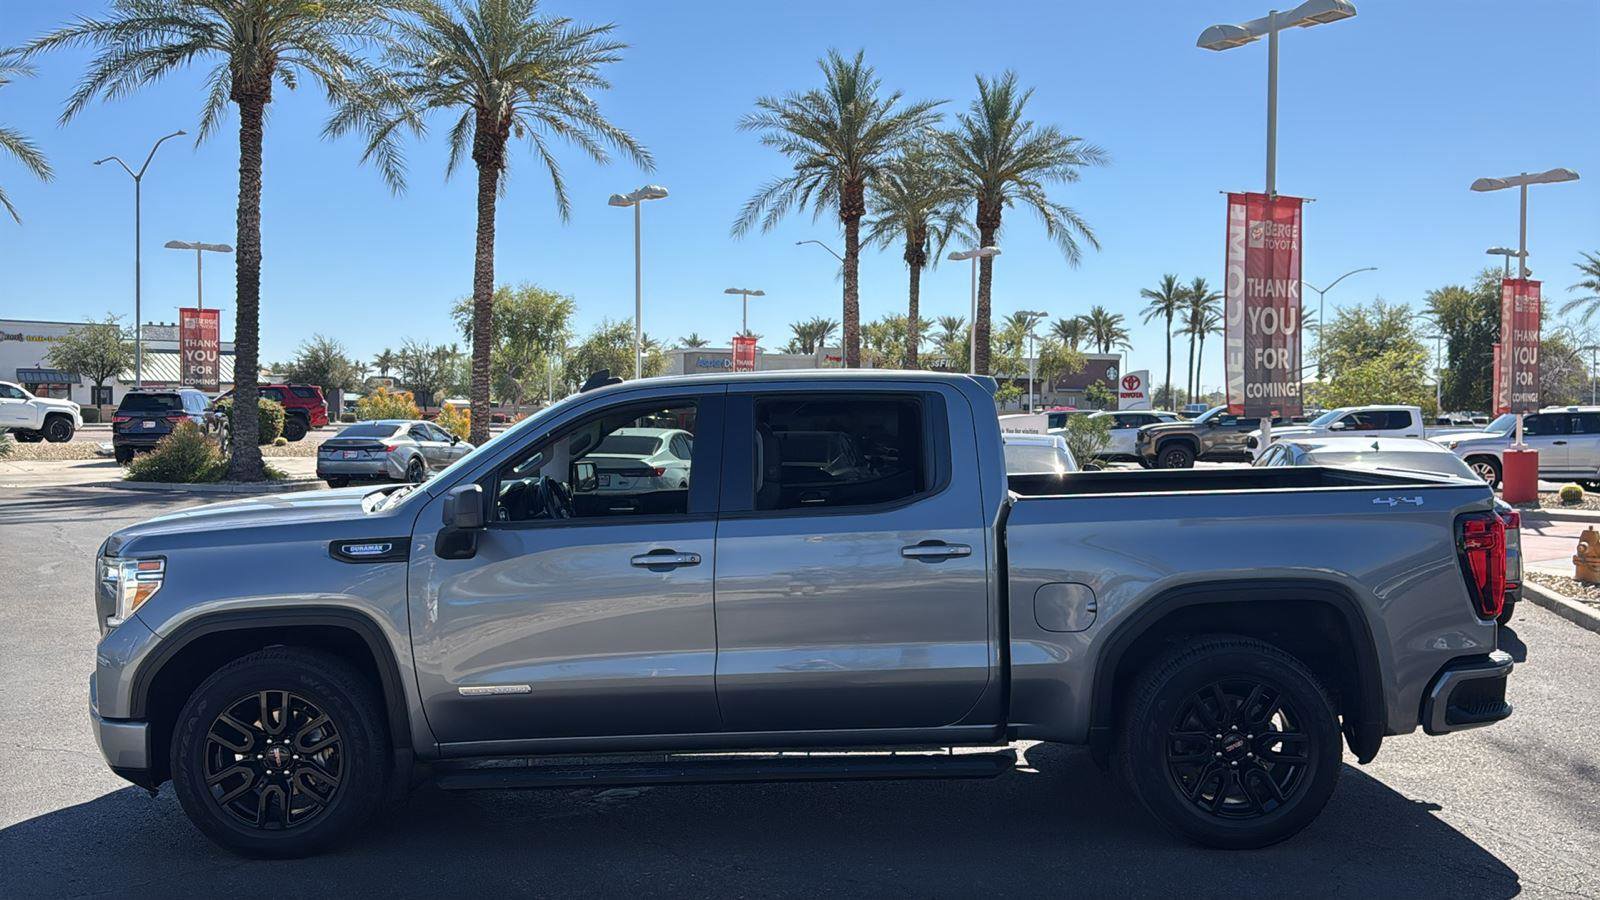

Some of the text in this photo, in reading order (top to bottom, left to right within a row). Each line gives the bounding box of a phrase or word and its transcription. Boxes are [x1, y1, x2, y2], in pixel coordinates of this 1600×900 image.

[1265, 220, 1298, 238] BERGE
[1265, 239, 1297, 250] TOYOTA
[1248, 278, 1298, 298] THANK
[1248, 307, 1296, 335] YOU
[1515, 330, 1538, 341] THANK
[185, 340, 218, 348] THANK
[185, 350, 216, 361] YOU
[1255, 348, 1289, 369] FOR
[1514, 347, 1537, 364] YOU
[190, 366, 212, 374] FOR
[1516, 372, 1533, 385] FOR
[1246, 382, 1300, 398] COMING!
